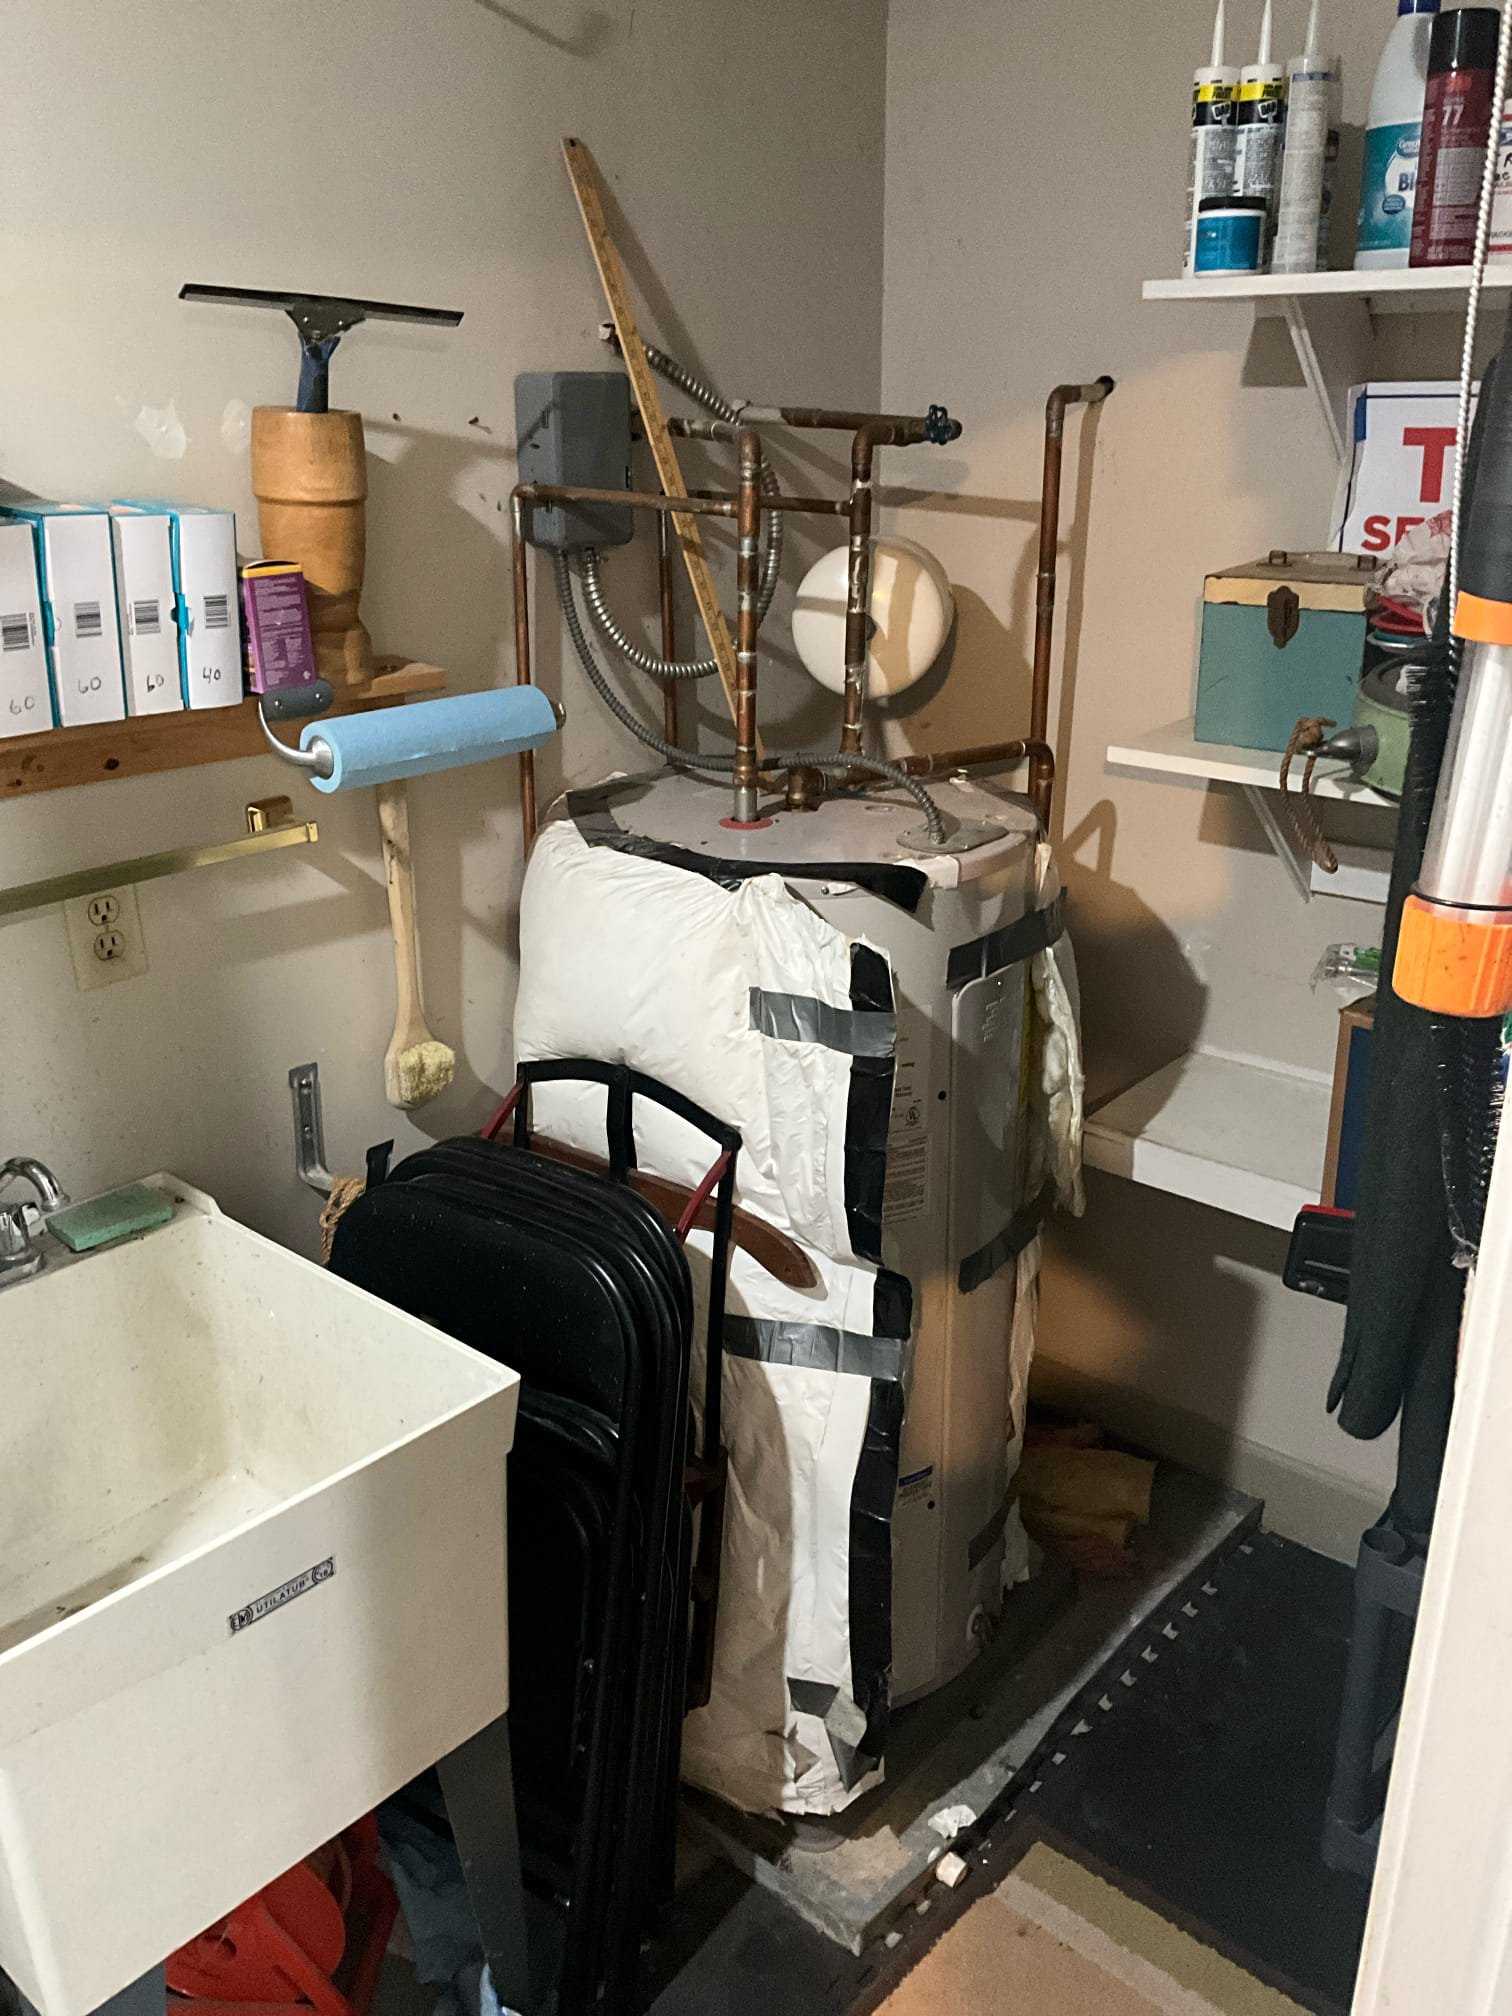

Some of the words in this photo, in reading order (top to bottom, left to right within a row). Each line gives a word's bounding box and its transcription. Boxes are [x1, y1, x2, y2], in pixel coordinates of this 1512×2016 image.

[1214, 103, 1231, 118] DAP
[1261, 101, 1277, 117] DAP
[1442, 105, 1463, 125] 77
[1403, 427, 1458, 503] T
[147, 674, 164, 693] 60
[203, 667, 221, 684] 40
[78, 677, 101, 694] 60
[10, 696, 35, 715] 60
[256, 1580, 306, 1613] UTILATUB
